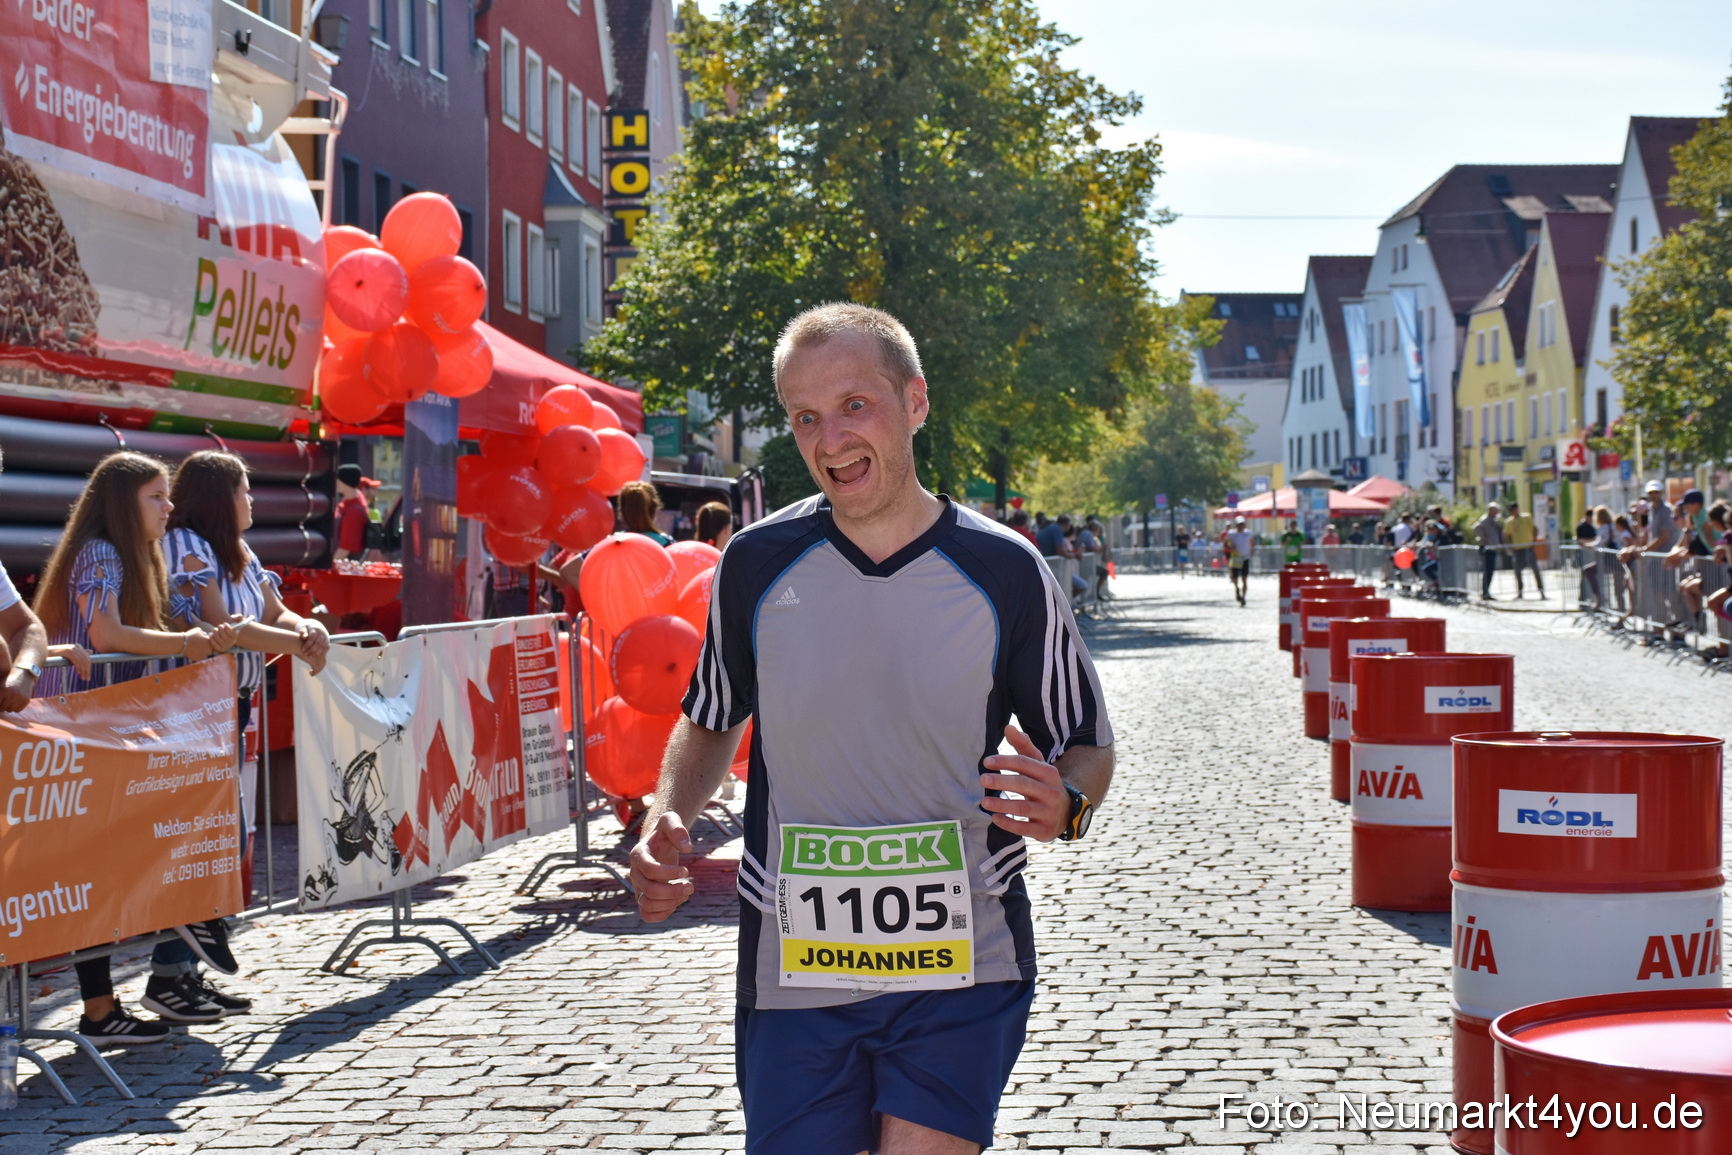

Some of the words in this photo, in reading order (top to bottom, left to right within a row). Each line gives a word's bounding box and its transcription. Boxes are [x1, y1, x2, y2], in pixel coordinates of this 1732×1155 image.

[35, 64, 196, 179] Energieberatung
[183, 257, 300, 371] Pellets
[775, 597, 801, 606] adidas
[12, 738, 85, 780] CODE
[147, 753, 170, 769] Ihrer
[171, 748, 208, 768] Projekte
[125, 774, 186, 796] Grafikdesign
[185, 768, 206, 786] und
[1357, 765, 1424, 800] AVIA
[6, 778, 93, 826] CLINIC
[153, 818, 192, 839] Melden
[205, 810, 225, 829] sich
[1565, 826, 1613, 837] energie
[793, 831, 949, 869] BOCK
[178, 860, 209, 881] 09181
[952, 885, 962, 895] B
[0, 881, 93, 937] gentur
[800, 883, 949, 934] 1105
[799, 947, 954, 971] JOHANNES
[1636, 918, 1722, 981] AVIA
